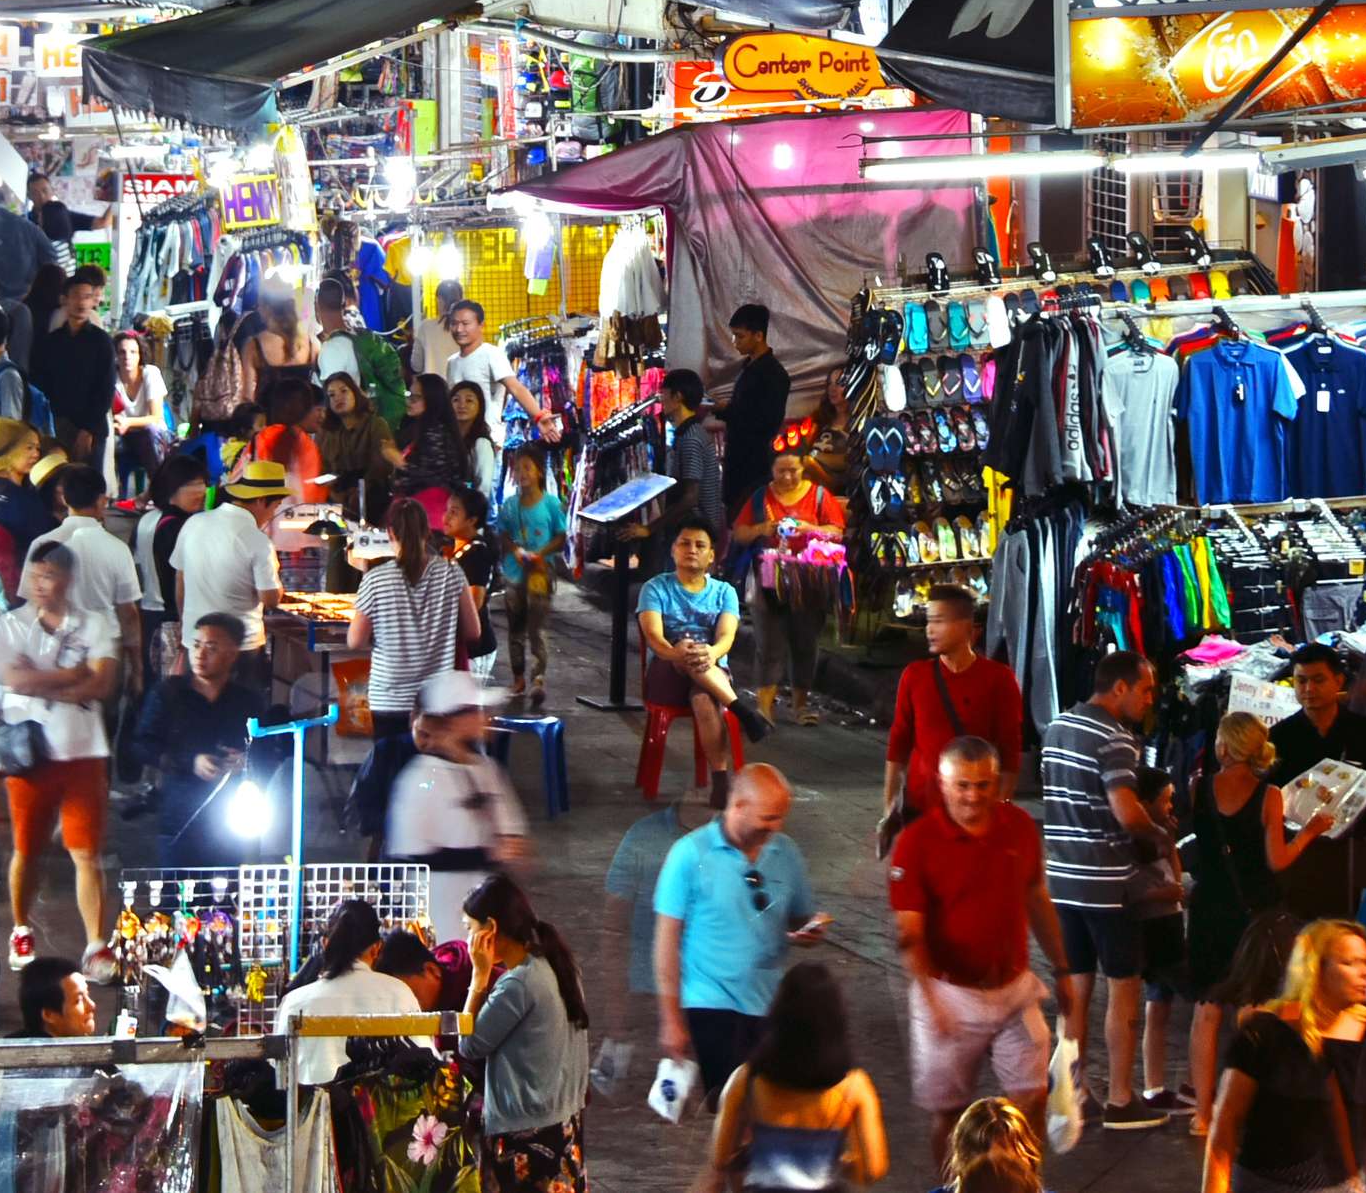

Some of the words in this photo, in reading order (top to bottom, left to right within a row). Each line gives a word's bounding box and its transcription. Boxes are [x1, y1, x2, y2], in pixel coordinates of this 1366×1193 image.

[733, 43, 811, 79] Center
[819, 50, 871, 74] Point
[797, 77, 843, 100] SHOPPING
[846, 76, 869, 99] MALL
[124, 179, 199, 194] SIAM
[223, 181, 280, 224] HENN
[1064, 392, 1080, 451] adidas
